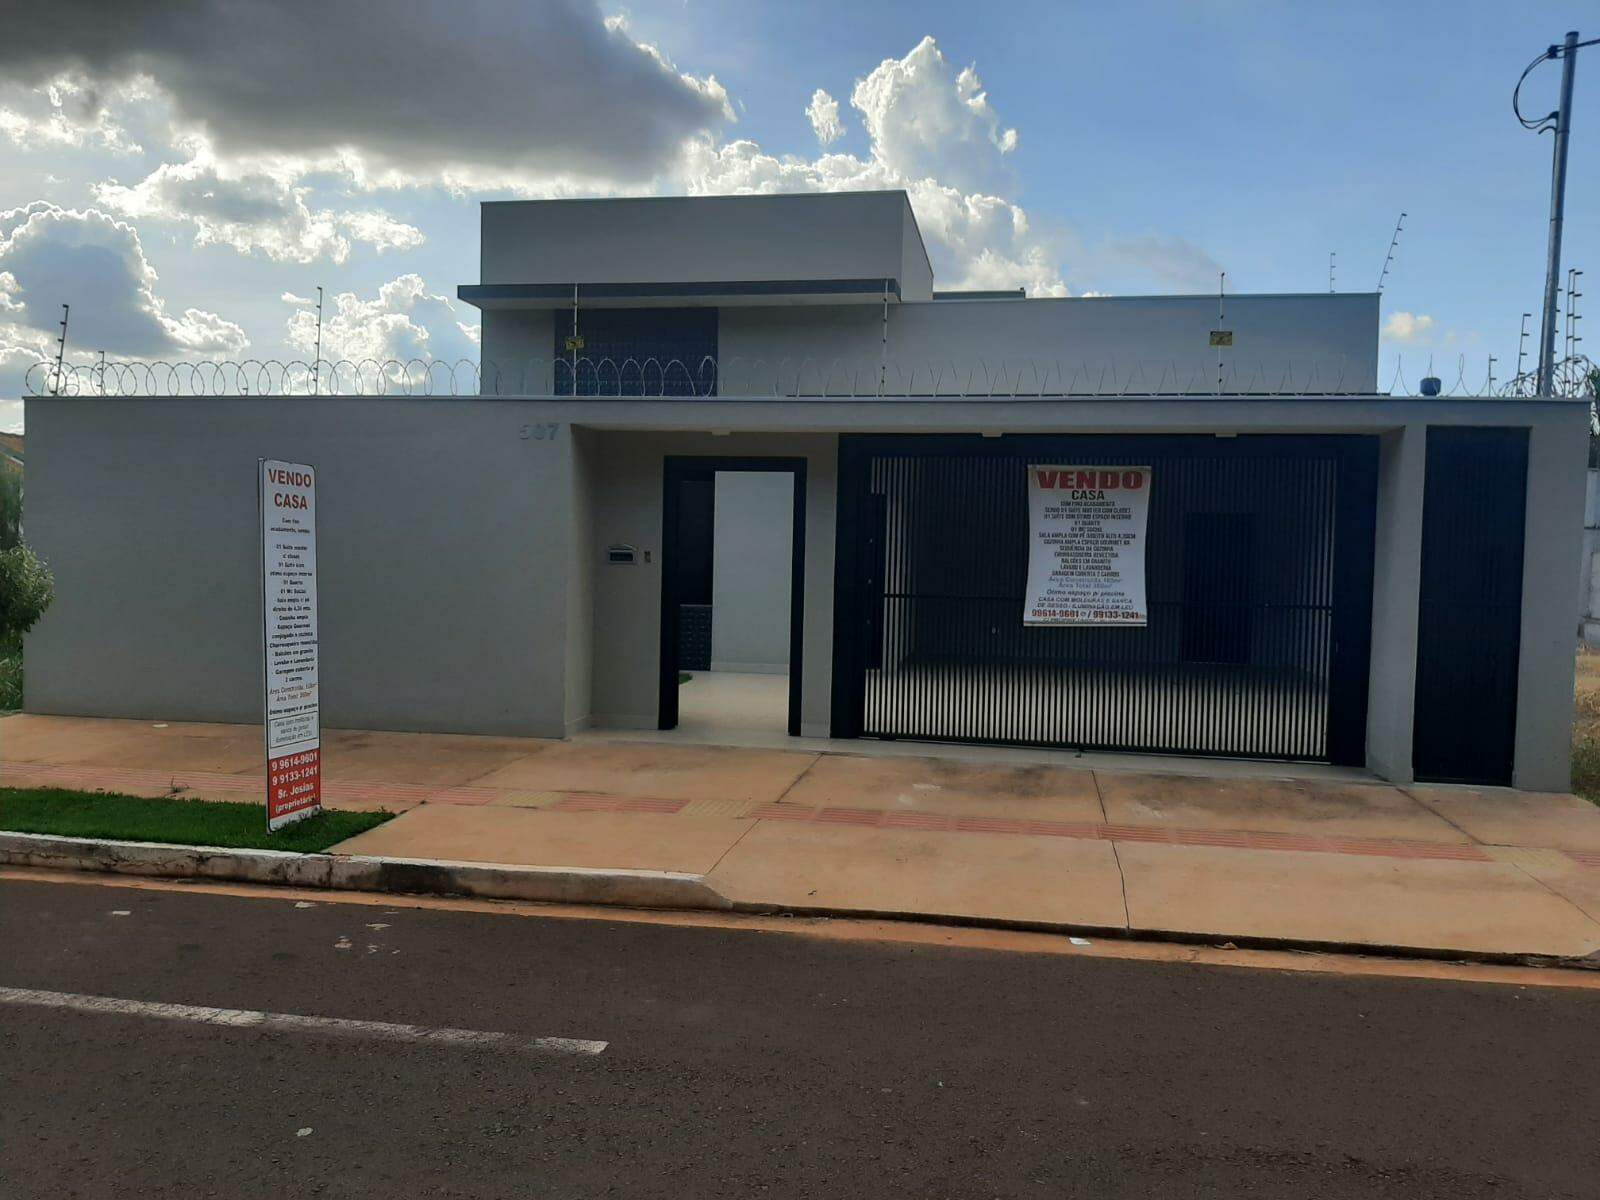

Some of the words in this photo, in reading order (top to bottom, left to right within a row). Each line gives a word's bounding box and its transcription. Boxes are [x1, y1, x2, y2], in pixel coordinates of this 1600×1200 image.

[268, 468, 312, 488] VENDO
[1037, 471, 1143, 490] VENDO
[274, 492, 308, 510] CASA
[1072, 490, 1105, 500] CASA
[272, 761, 278, 771] 9
[280, 752, 318, 770] 9614-9601
[280, 765, 318, 784] 9133-1241
[278, 789, 288, 799] Sr.
[290, 782, 314, 796] Josias
